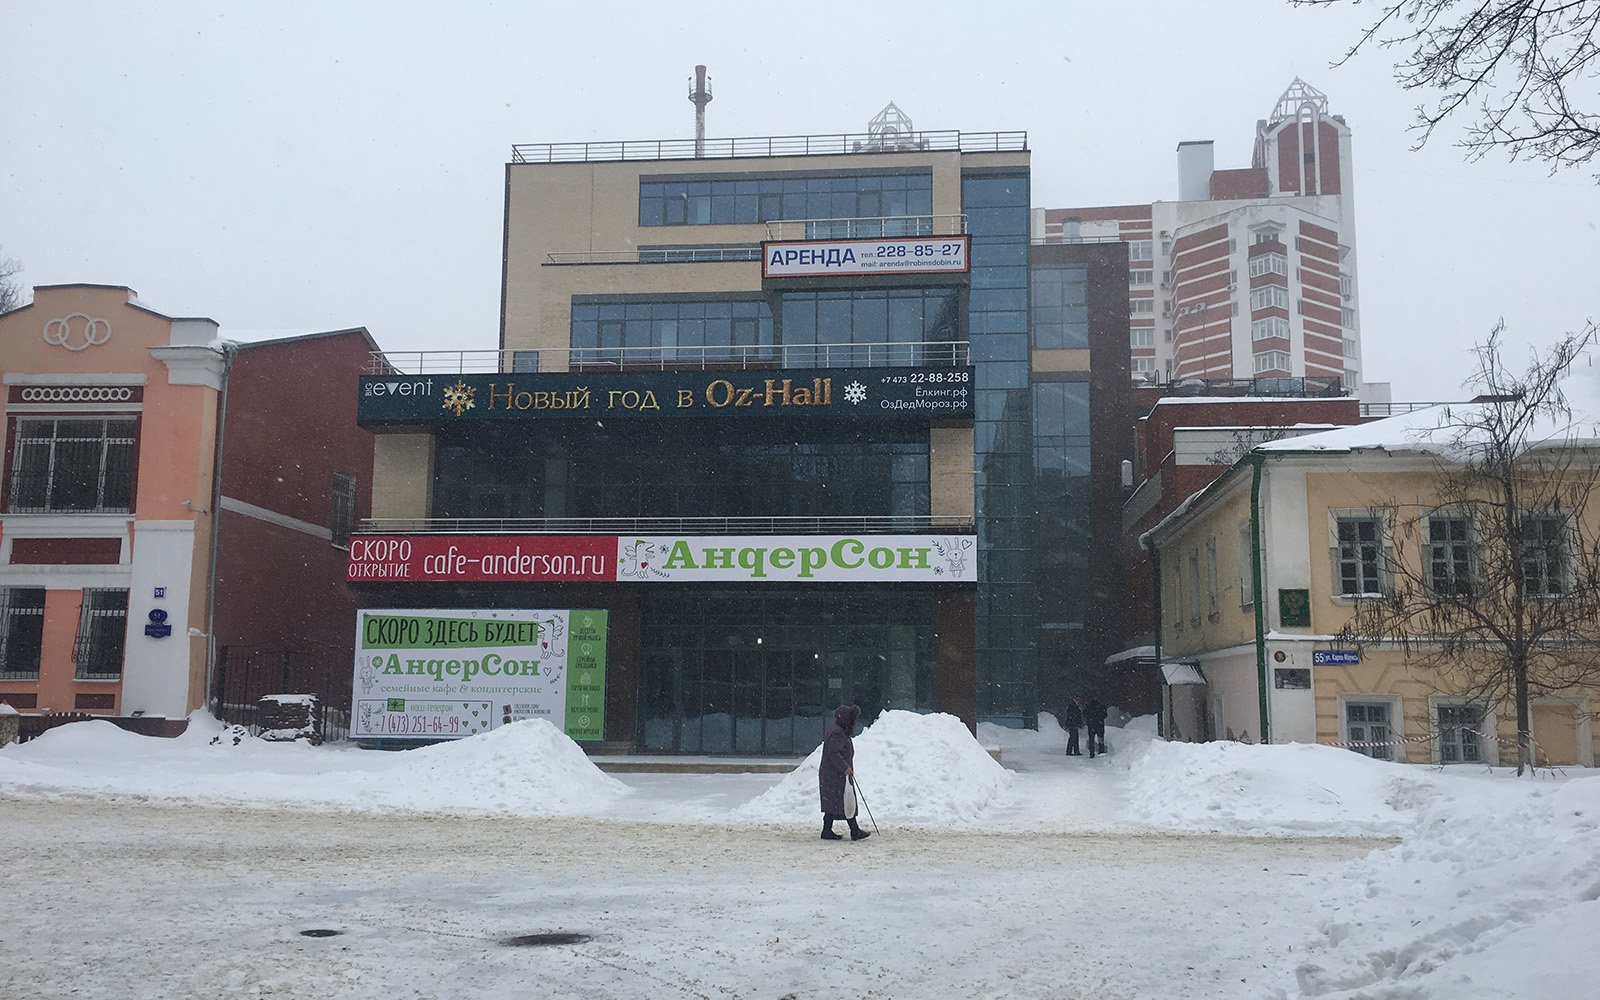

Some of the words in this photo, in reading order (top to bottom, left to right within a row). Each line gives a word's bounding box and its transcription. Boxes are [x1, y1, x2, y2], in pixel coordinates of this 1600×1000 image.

[770, 248, 856, 267] АРЕНДА
[877, 244, 961, 258] 228-85-27
[881, 376, 891, 384] +7
[892, 376, 908, 384] 473
[910, 373, 969, 383] 22-88-258
[488, 384, 591, 410] Новый
[608, 390, 660, 411] год
[706, 377, 832, 408] Oz-Hall
[916, 386, 968, 398] Ёлкинг.рф
[880, 399, 968, 410] ОзДедМороз.рф
[350, 540, 412, 562] СКОРО
[424, 546, 604, 575] cafe-anderson.ru
[349, 563, 410, 578] ОТКРЫТИЕ
[366, 618, 420, 644] СКОРО
[424, 619, 478, 646] ЗДЕСЬ
[485, 622, 536, 643] БУДЕТ
[1315, 653, 1324, 662] 55
[380, 684, 429, 693] семейные
[432, 684, 456, 695] кафе
[460, 685, 468, 693] &
[471, 686, 542, 696] кондитерские
[426, 704, 454, 714] телефон
[375, 716, 385, 731] +7
[388, 714, 409, 733] (473)
[412, 716, 459, 733] 251-64-99
